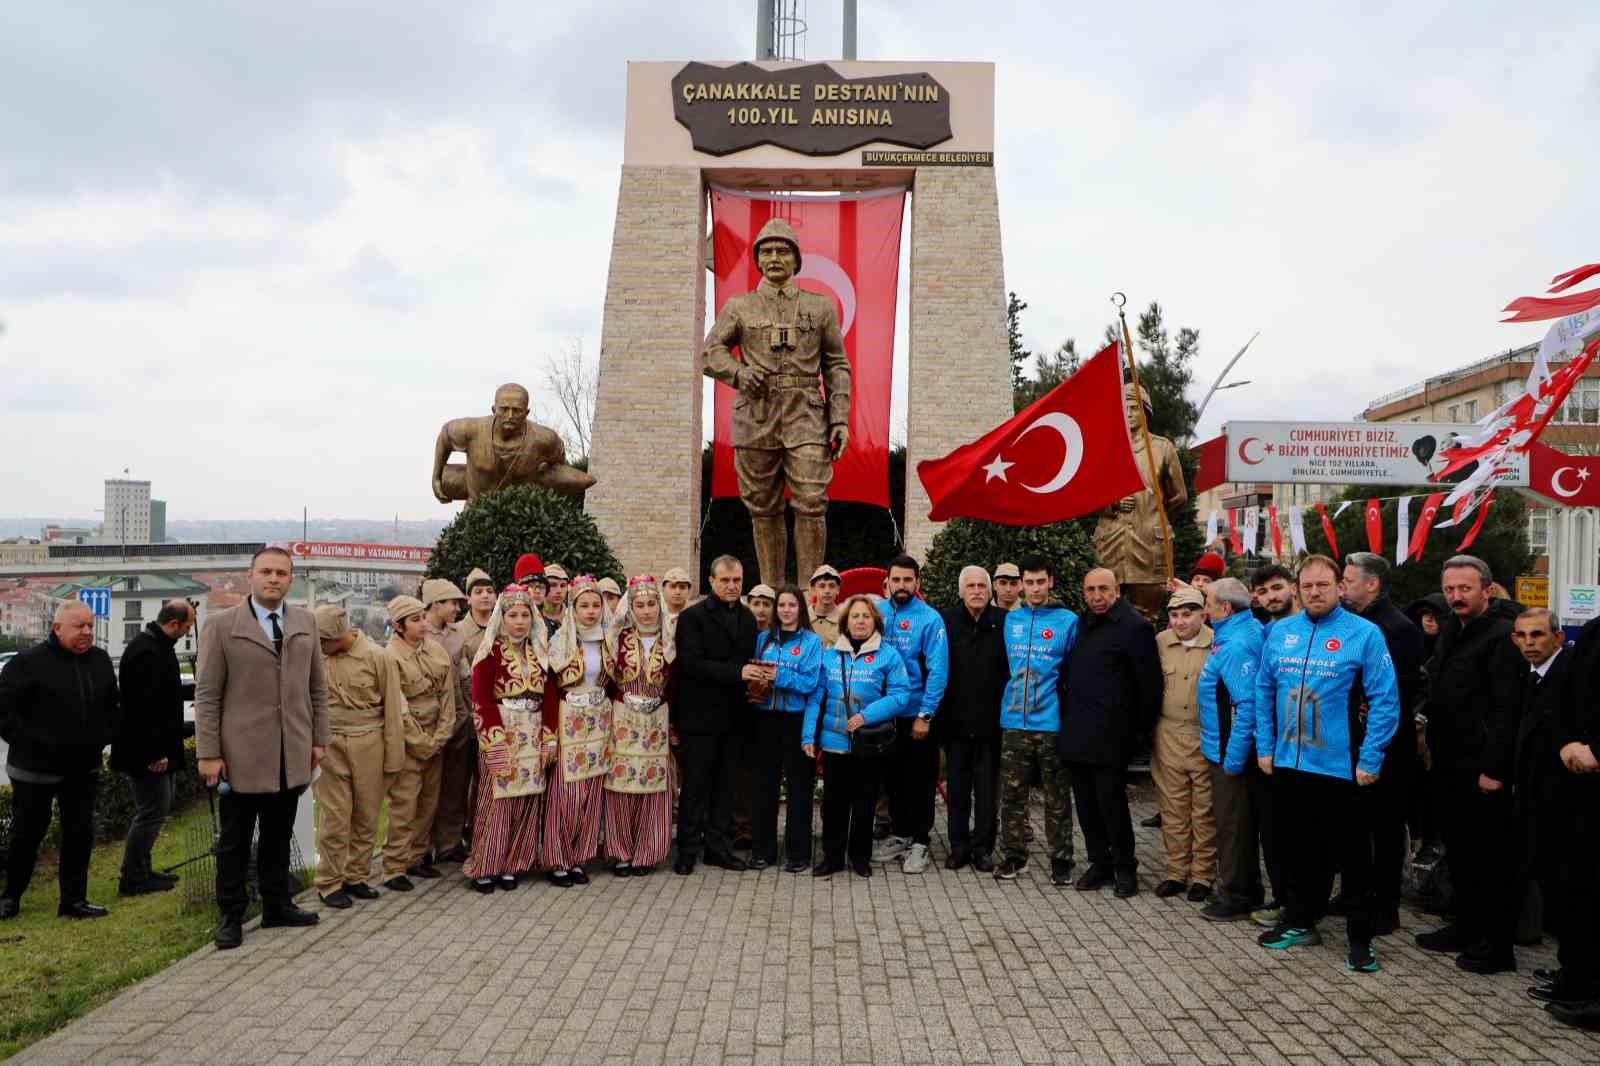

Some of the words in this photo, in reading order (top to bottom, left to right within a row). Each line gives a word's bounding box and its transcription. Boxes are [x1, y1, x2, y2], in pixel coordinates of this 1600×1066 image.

[683, 83, 801, 103] ÇANAKKALE
[814, 82, 939, 101] DESTANI'NIN
[727, 107, 798, 125] 100.YIL
[811, 108, 894, 126] ANISINA
[1290, 428, 1362, 442] CUMHURİYET
[1278, 444, 1309, 457] BİZİM
[1313, 444, 1410, 458] CUMHURİYETİMİZ
